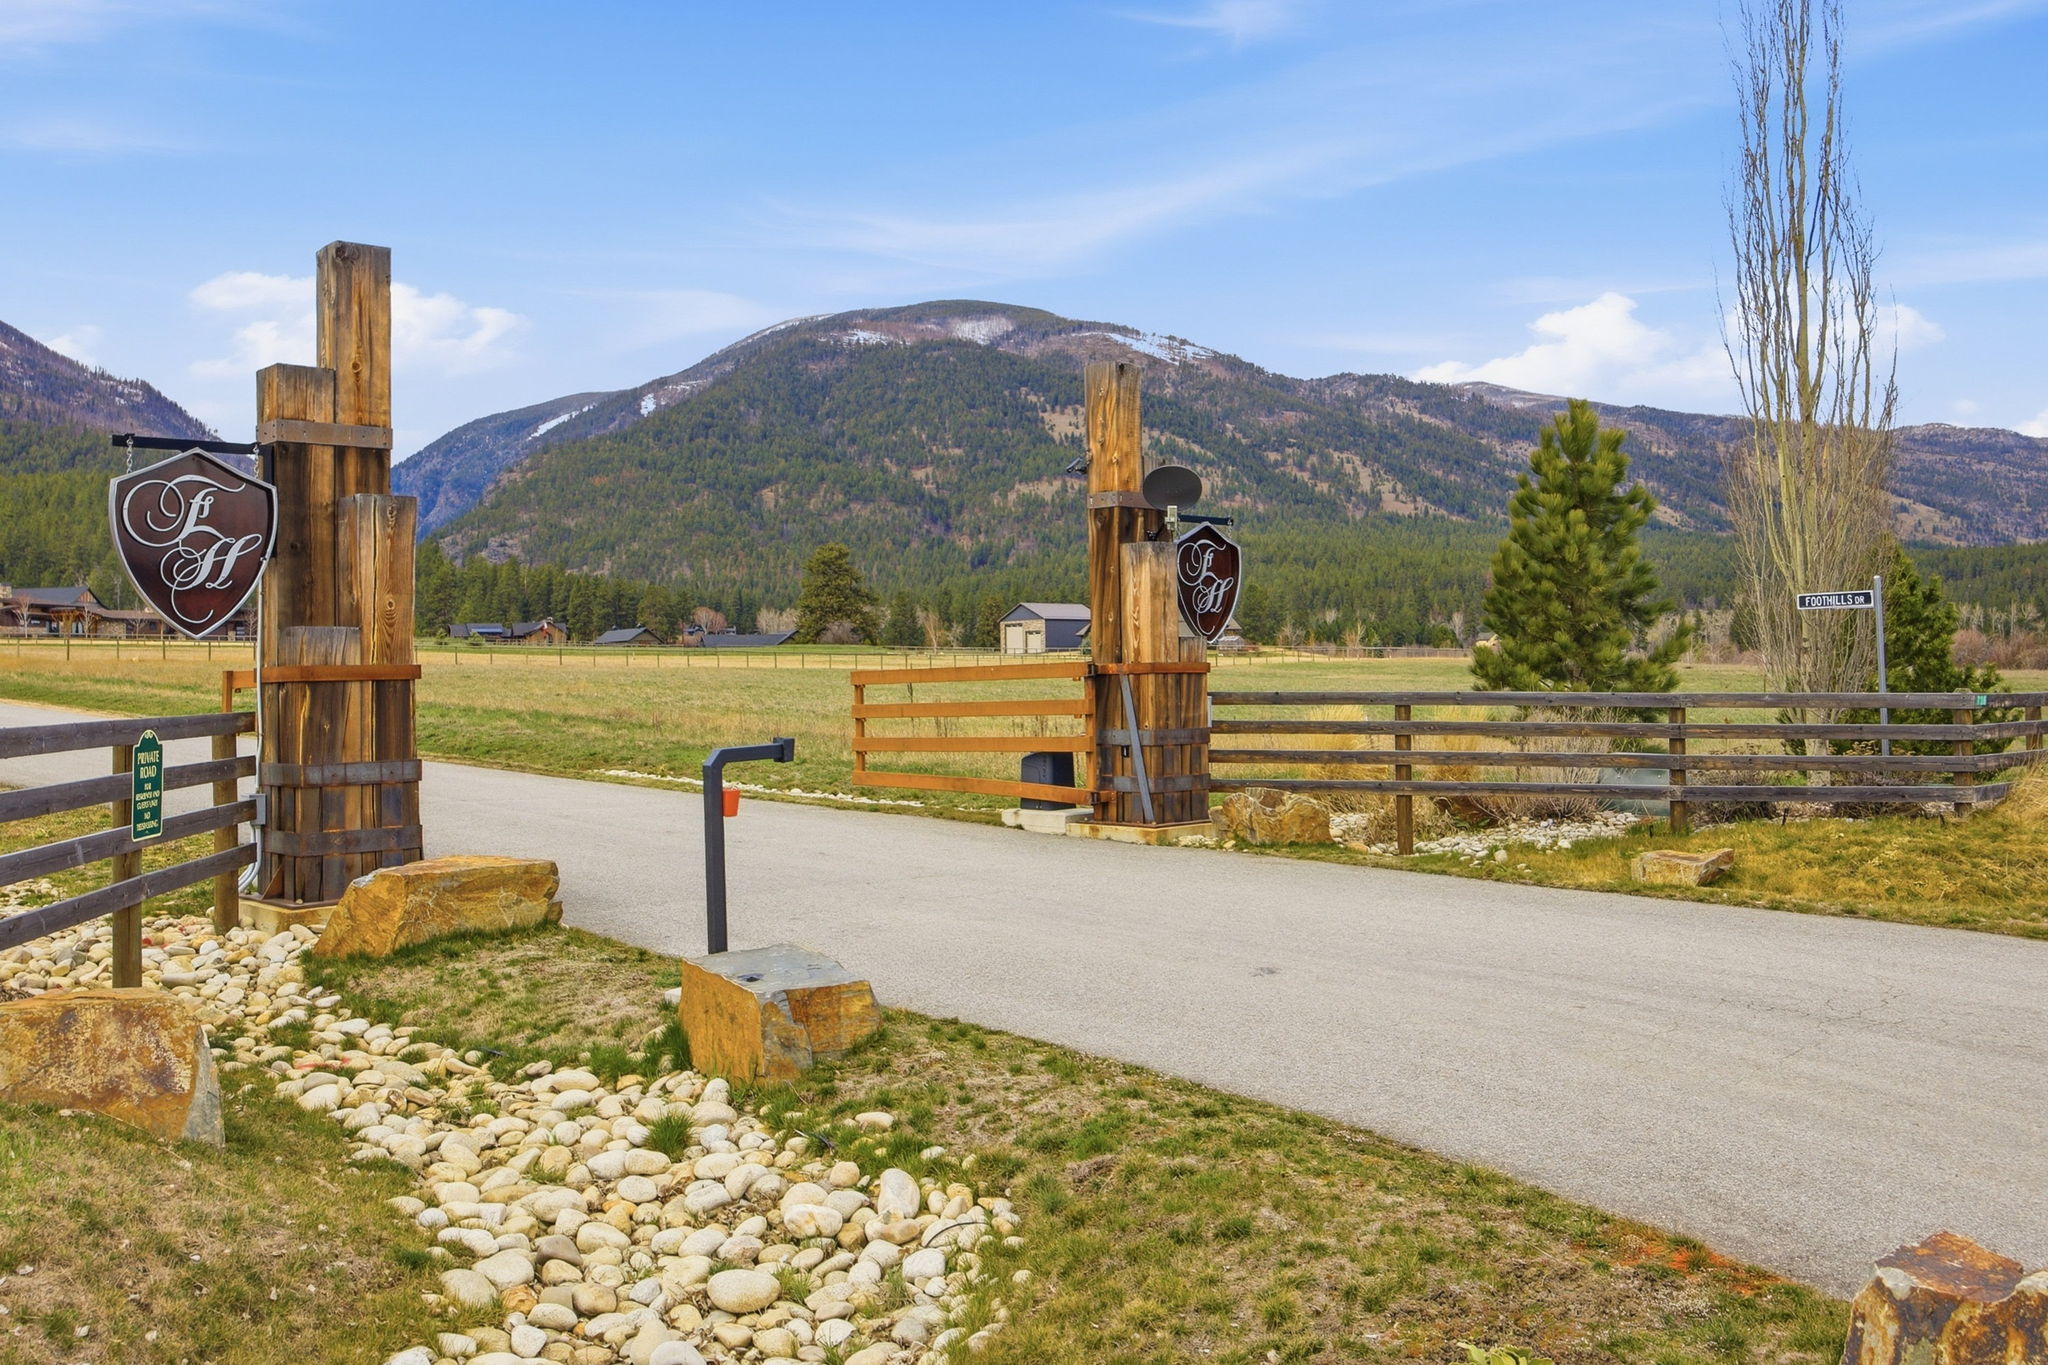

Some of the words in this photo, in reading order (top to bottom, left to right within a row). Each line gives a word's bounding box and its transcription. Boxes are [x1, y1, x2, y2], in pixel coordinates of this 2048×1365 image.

[1805, 594, 1853, 607] FOOTHILLS
[1854, 595, 1865, 604] DR
[137, 751, 160, 765] PRIVATE
[139, 765, 157, 779] ROAD
